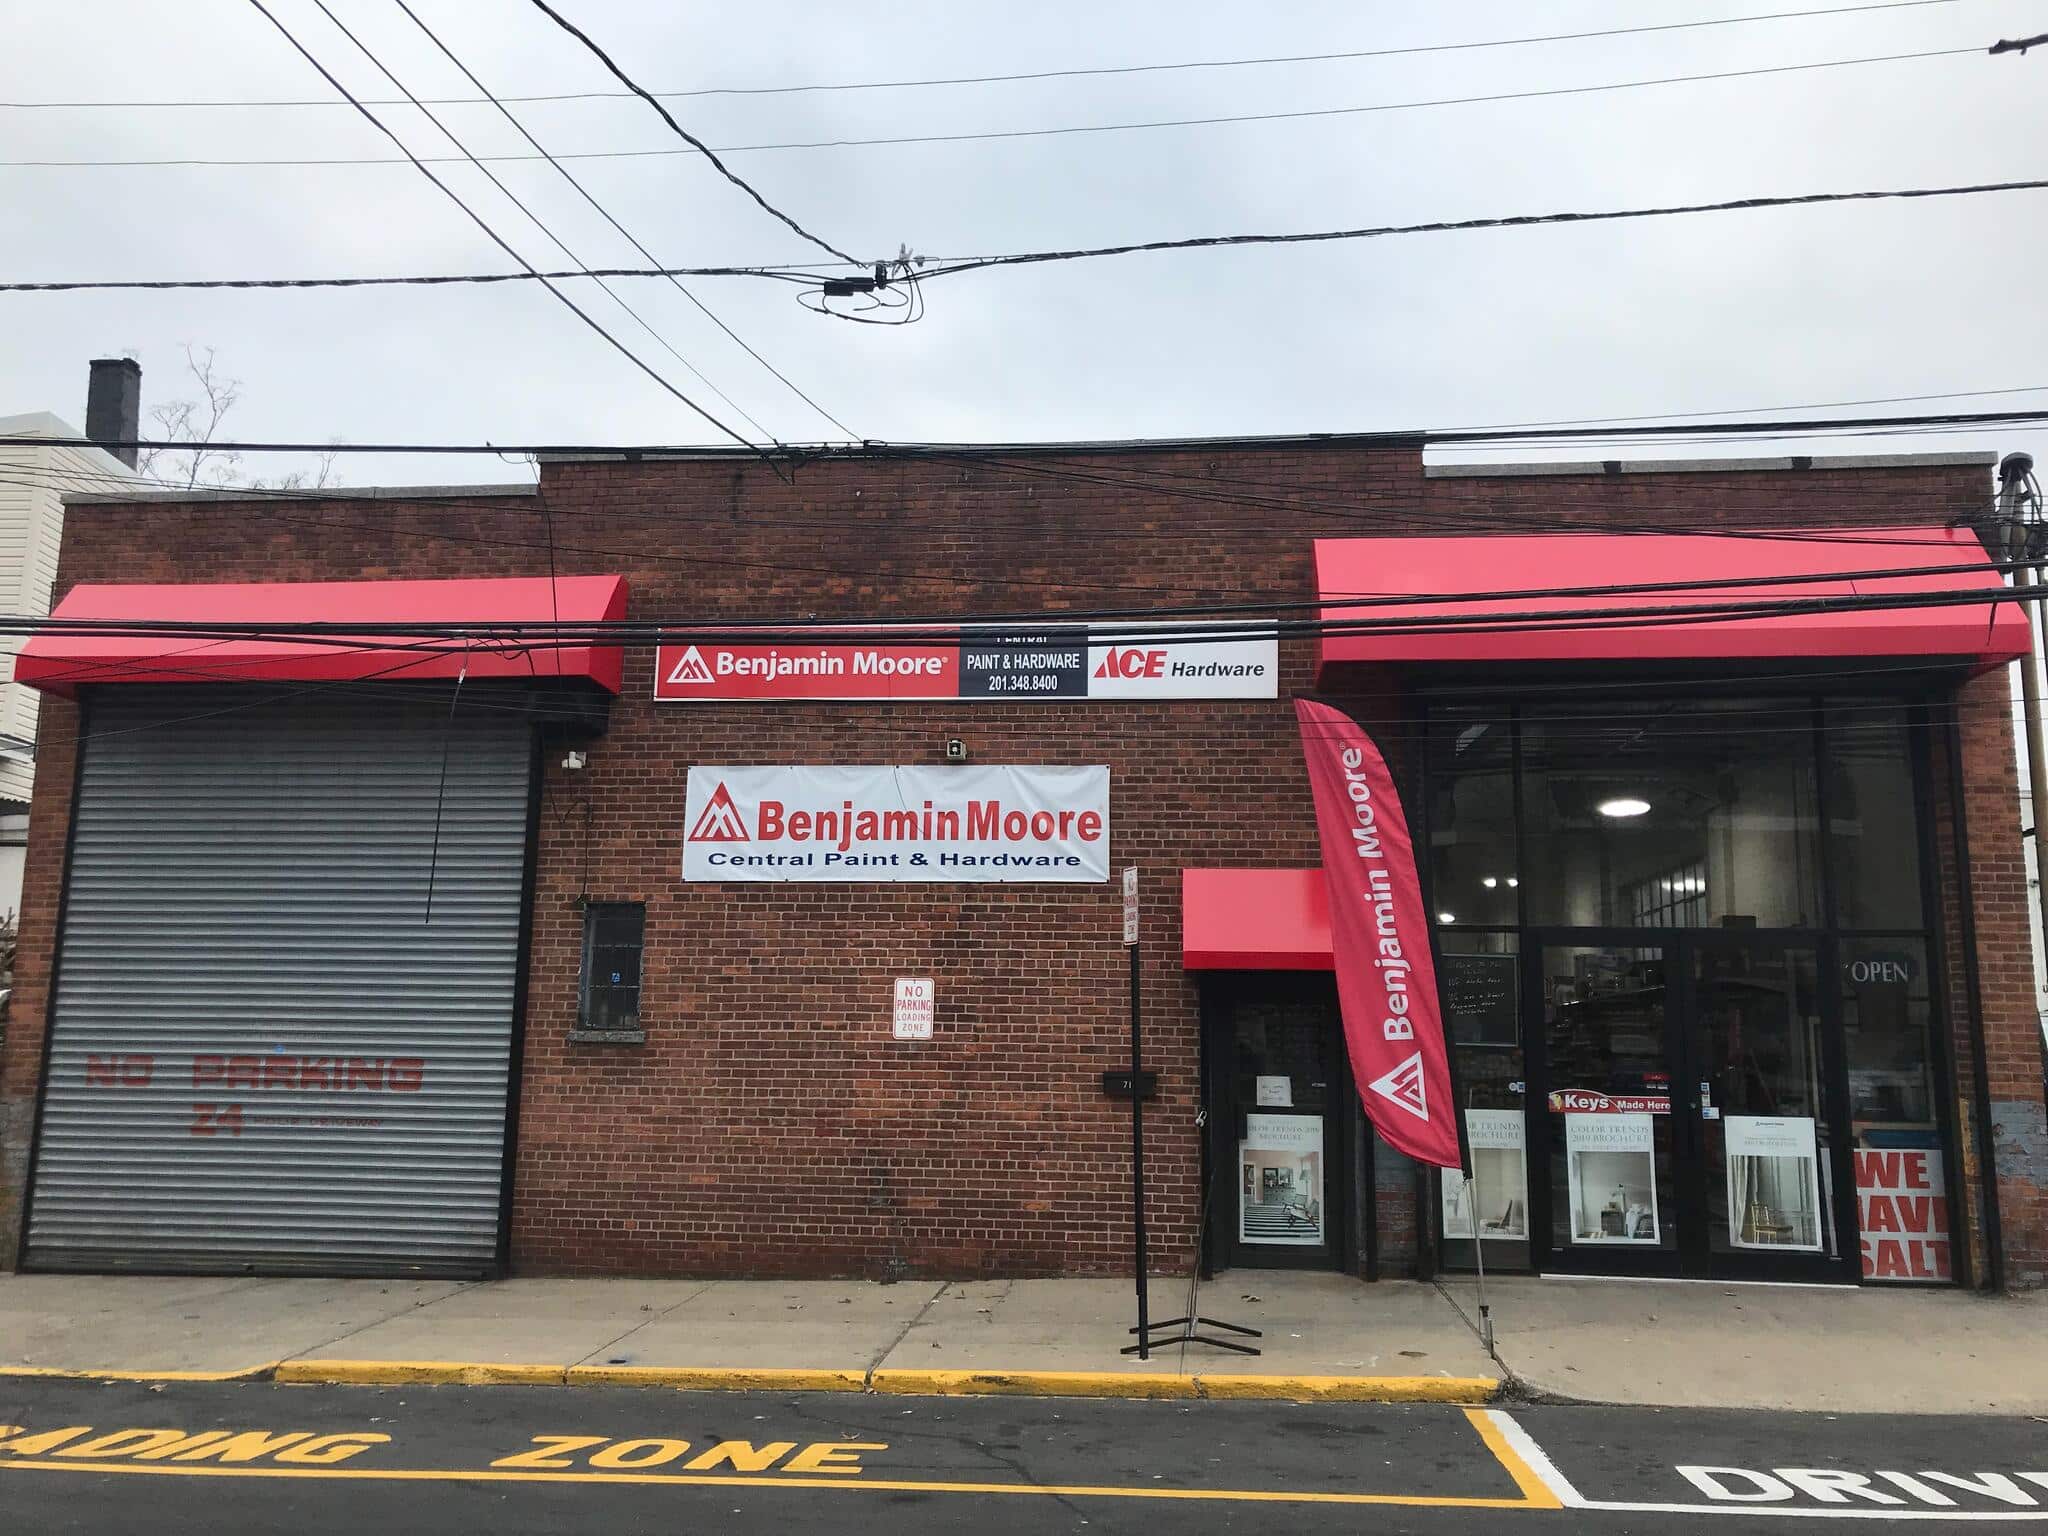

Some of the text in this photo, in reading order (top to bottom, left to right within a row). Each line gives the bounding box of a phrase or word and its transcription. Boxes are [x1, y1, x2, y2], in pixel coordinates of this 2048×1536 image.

[716, 651, 942, 681] Benjamin Moore
[967, 653, 1080, 669] PAINT & HARDWARE
[1094, 645, 1265, 679] ACE Hardware
[988, 675, 1058, 691] 201.348.8400
[758, 801, 1102, 852] Benjamin Moore
[708, 853, 1081, 866] Central Paint & Hardware
[1341, 747, 1415, 1041] Benjamin Moore
[1852, 961, 1908, 982] OPEN
[905, 986, 923, 997] NO
[897, 1000, 931, 1010] PARKING
[897, 1013, 931, 1021] LOADING
[902, 1024, 925, 1032] ZONE
[85, 1054, 424, 1091] NO PARKING
[1565, 1095, 1609, 1111] Keys
[1617, 1101, 1644, 1109] Made
[190, 1103, 245, 1137] 24
[1854, 1152, 1930, 1188] WE
[0, 1425, 889, 1473] ADING ZONE
[1675, 1466, 2048, 1505] DRIV
